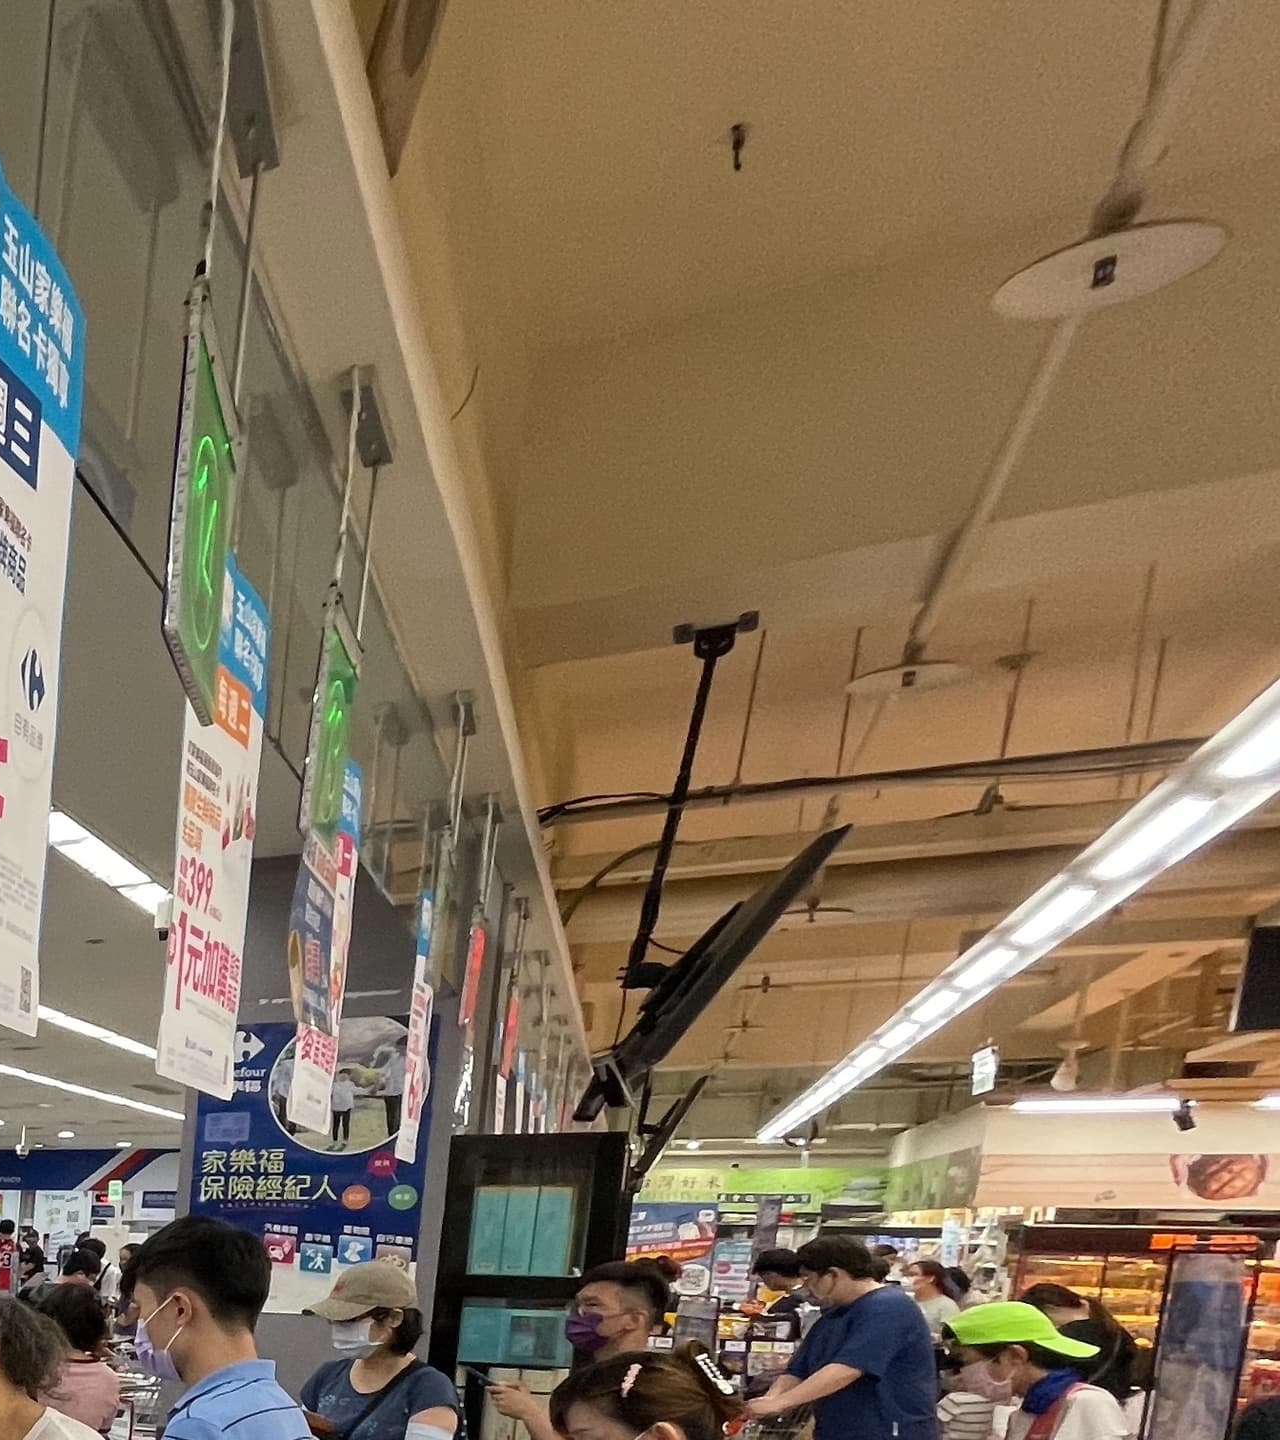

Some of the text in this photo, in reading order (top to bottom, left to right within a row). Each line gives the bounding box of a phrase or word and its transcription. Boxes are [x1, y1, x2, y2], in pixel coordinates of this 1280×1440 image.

[201, 1148, 287, 1174] 家樂福
[199, 1174, 338, 1201] 保險經紀人
